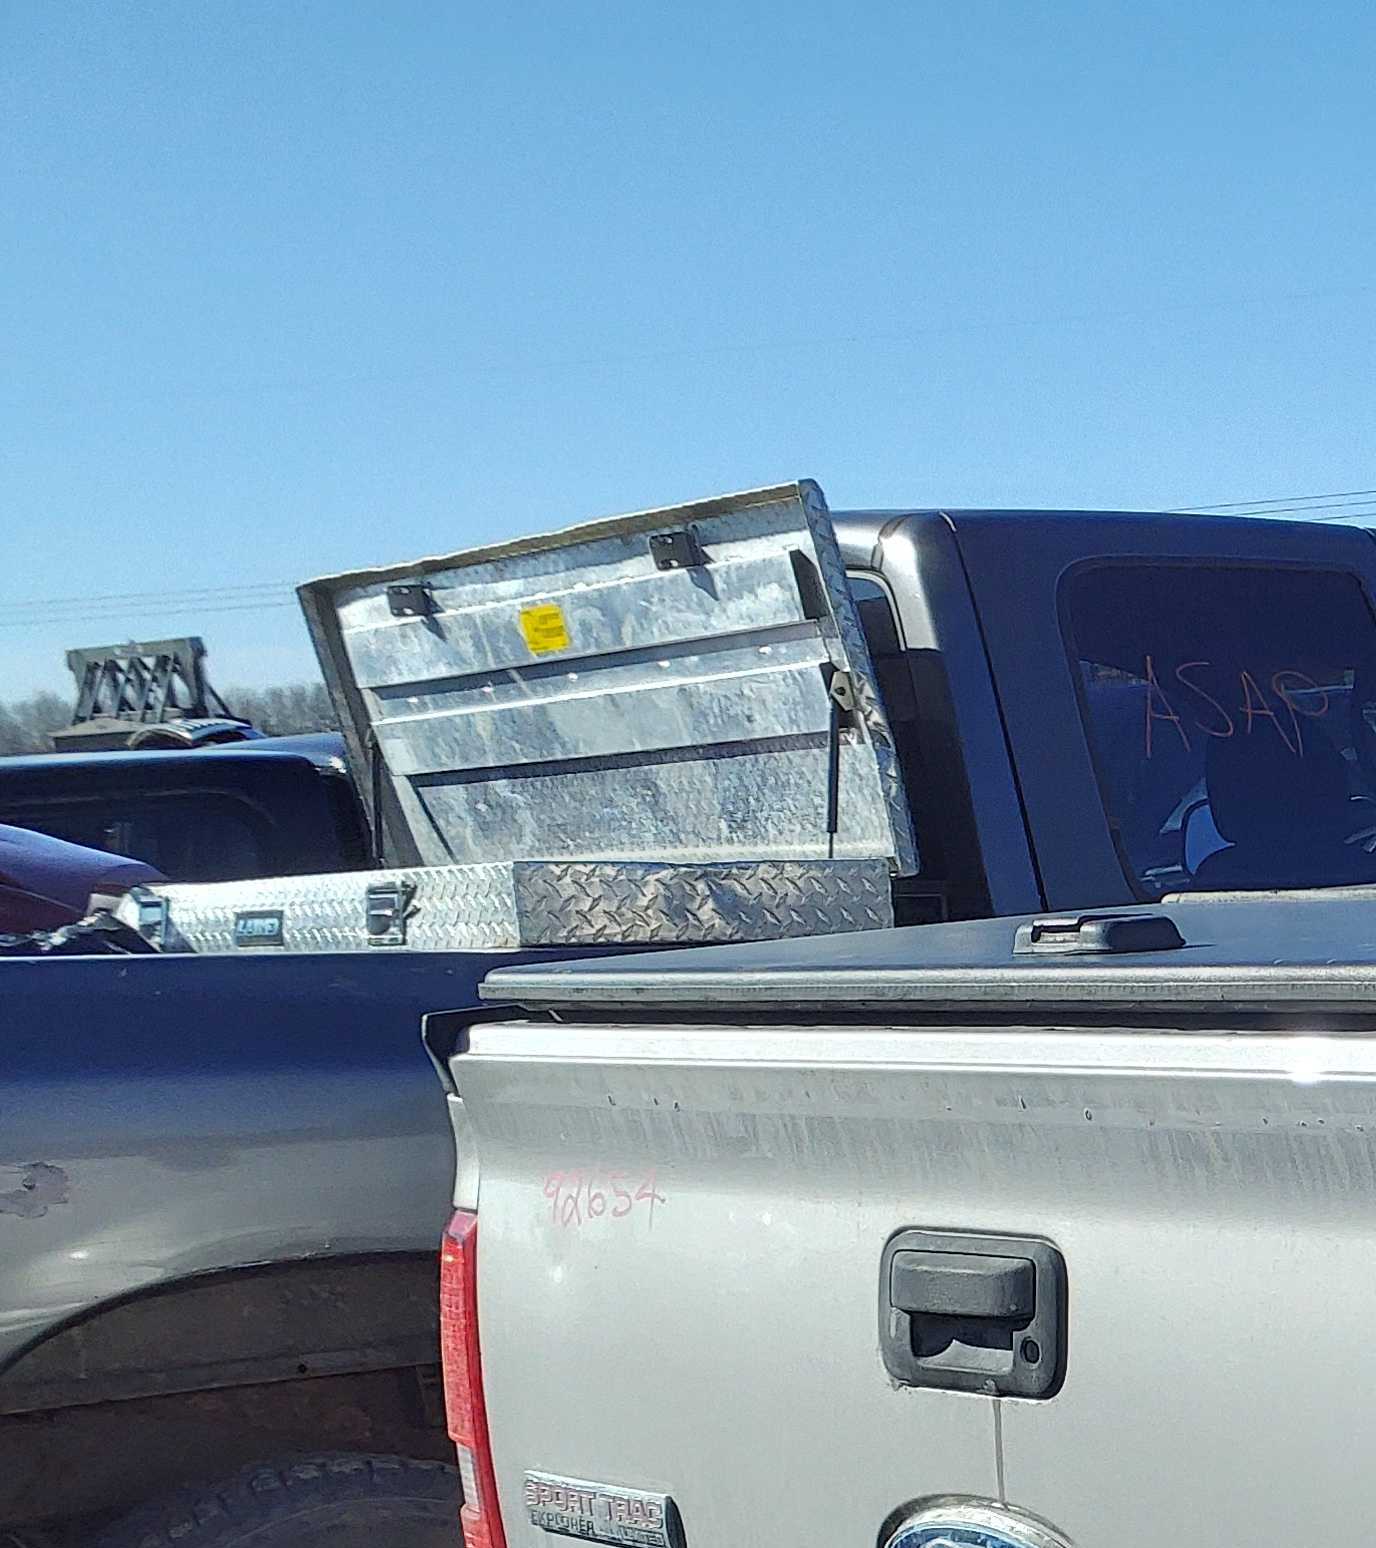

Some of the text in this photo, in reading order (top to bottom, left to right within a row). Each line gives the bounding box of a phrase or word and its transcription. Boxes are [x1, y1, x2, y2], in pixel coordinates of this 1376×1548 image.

[1143, 654, 1331, 759] ASAP
[542, 1167, 667, 1230] 92654
[525, 1480, 665, 1530] SPORT TRAC
